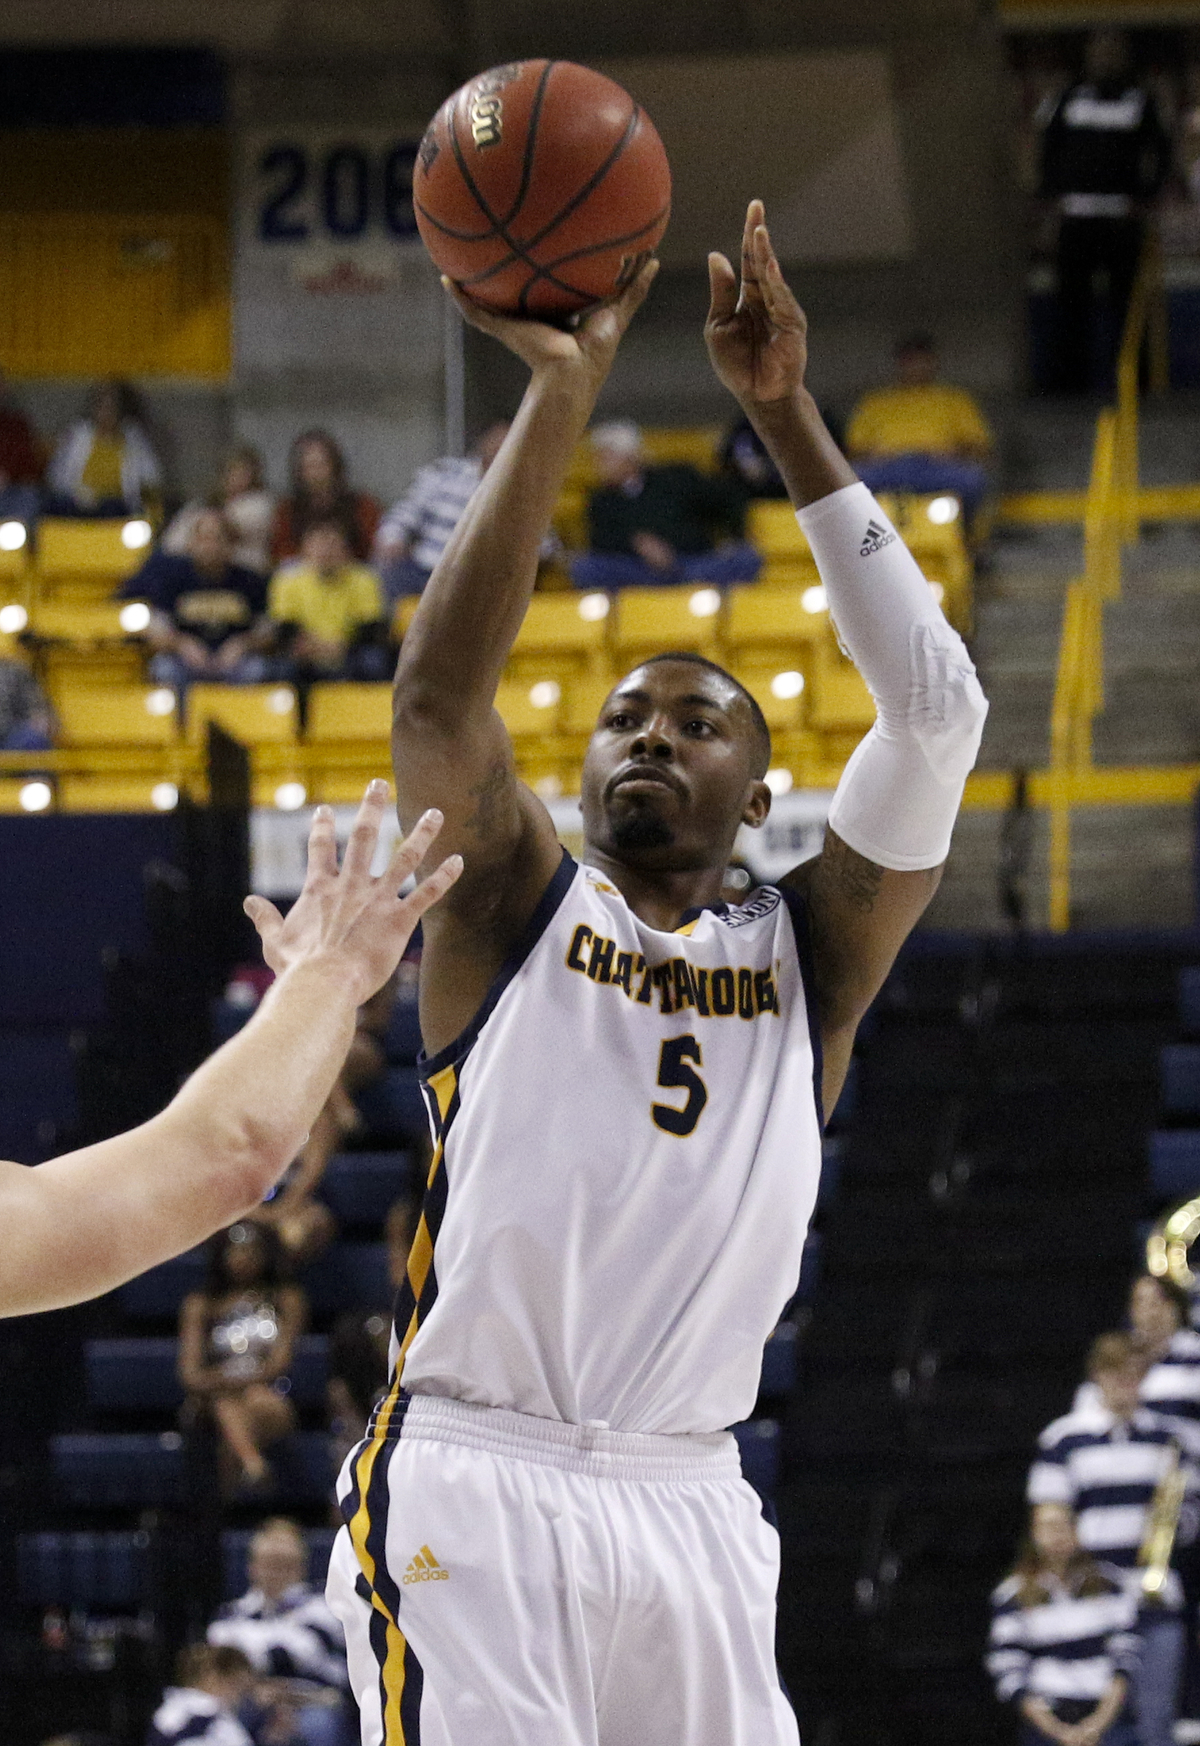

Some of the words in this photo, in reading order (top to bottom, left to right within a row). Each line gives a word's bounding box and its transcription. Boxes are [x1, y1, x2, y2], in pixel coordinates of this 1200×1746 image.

[860, 533, 896, 557] adidas
[565, 922, 781, 1022] CHATTANOOG
[651, 1033, 709, 1138] 5
[402, 1568, 449, 1585] adidas
